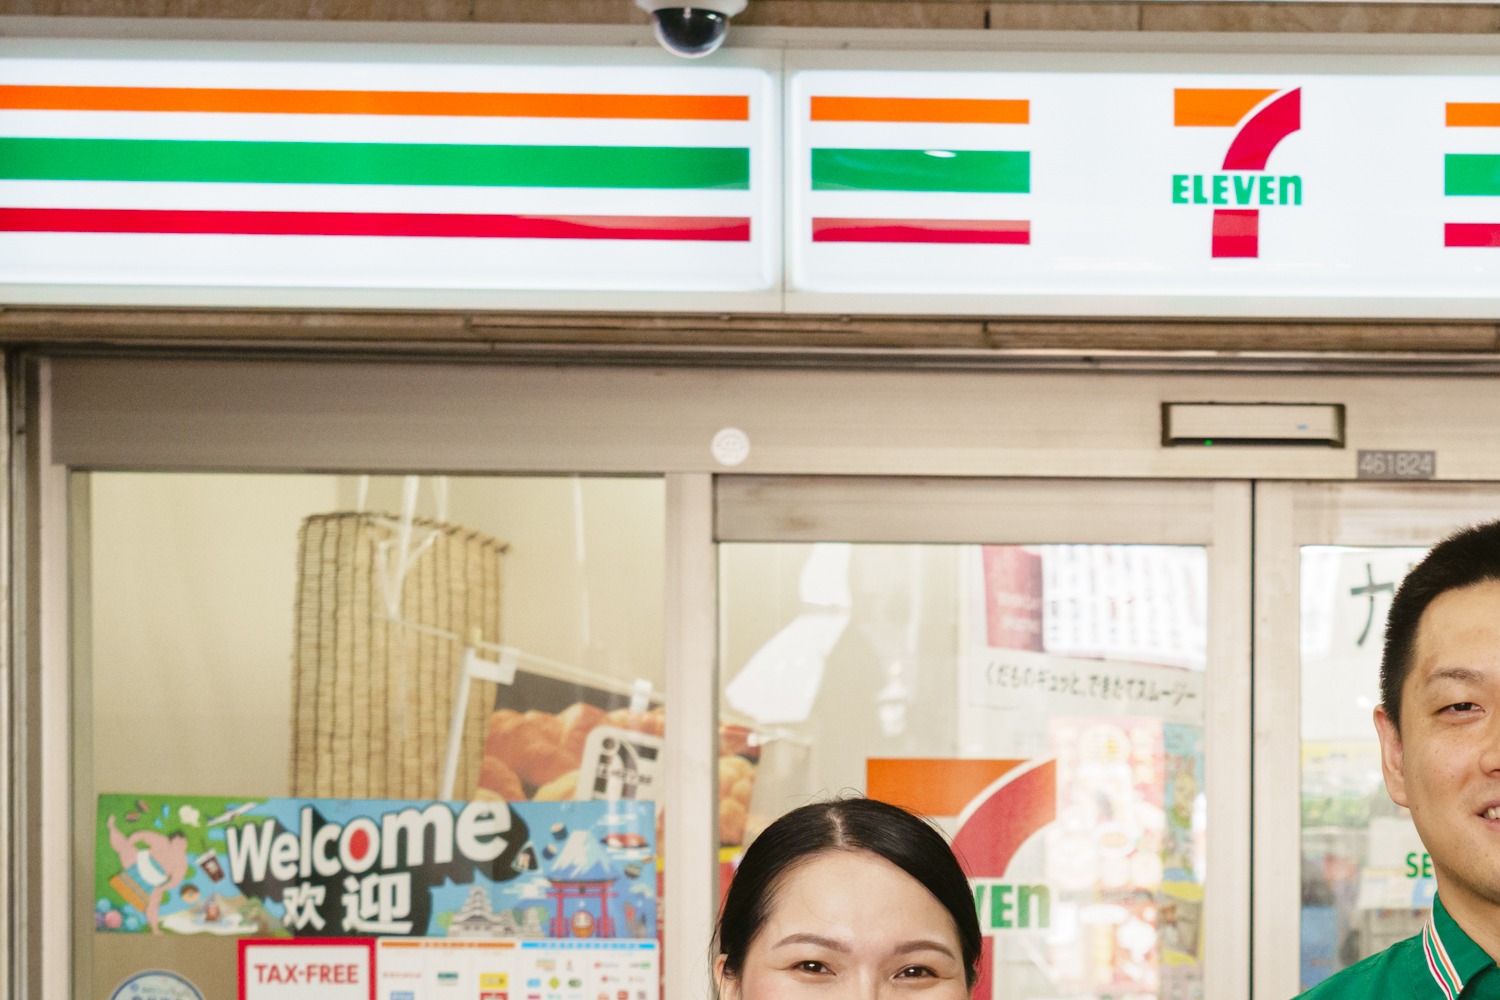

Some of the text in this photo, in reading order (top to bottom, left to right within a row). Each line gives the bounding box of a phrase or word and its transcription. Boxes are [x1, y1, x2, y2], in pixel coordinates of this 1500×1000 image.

[1173, 86, 1302, 258] 7
[1359, 453, 1433, 477] 461824
[226, 801, 513, 884] Welcome
[254, 964, 359, 984] TAX-FREE
